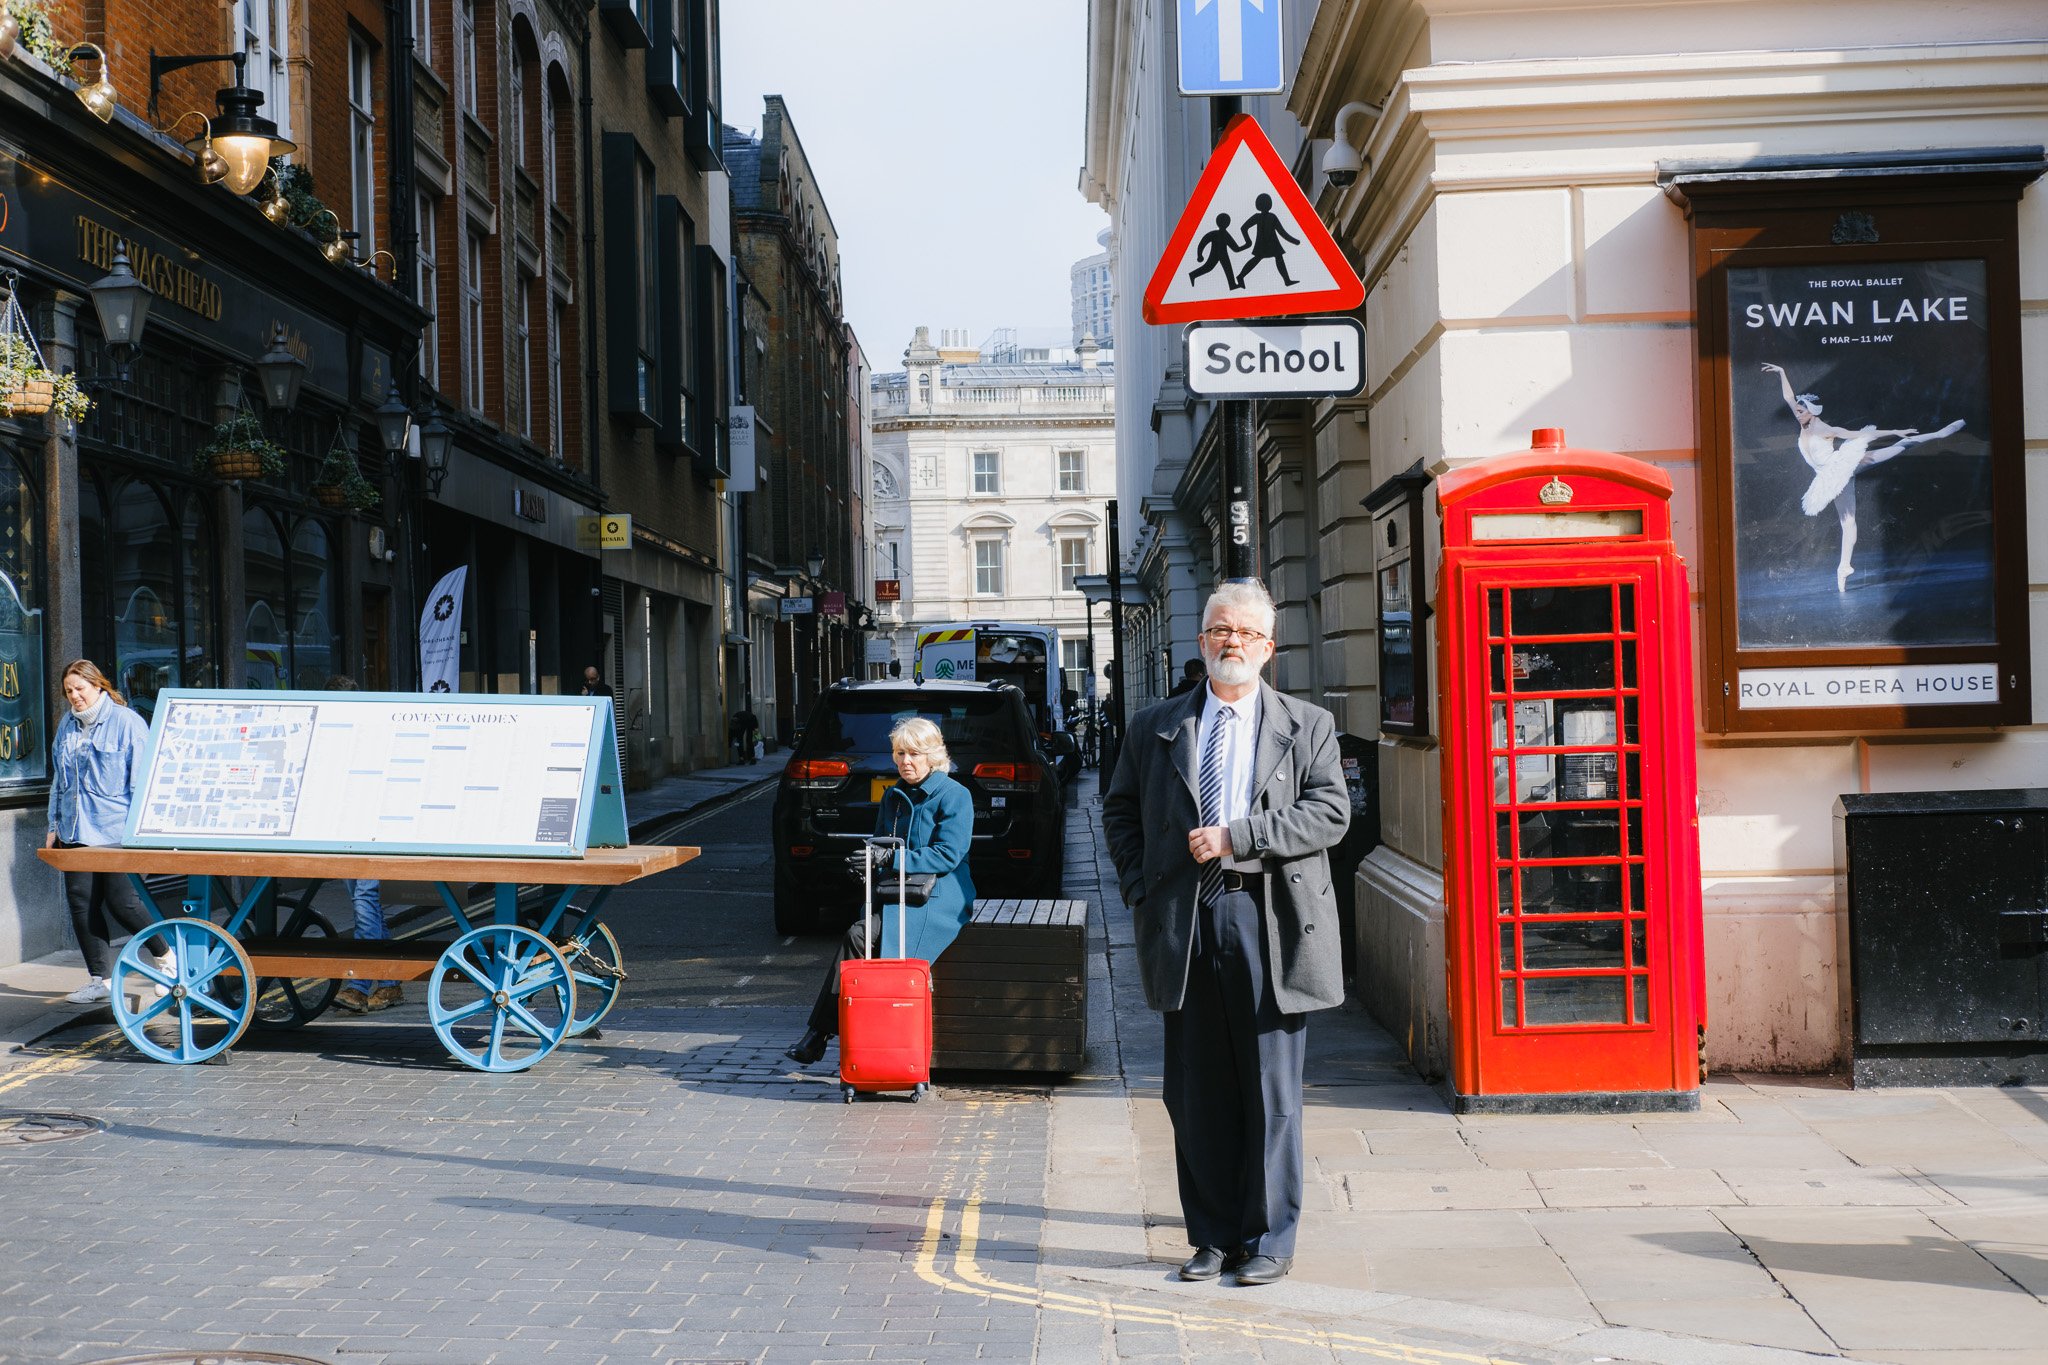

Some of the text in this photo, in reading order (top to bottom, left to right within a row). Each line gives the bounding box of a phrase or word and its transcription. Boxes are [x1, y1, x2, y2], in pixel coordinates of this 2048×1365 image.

[78, 215, 223, 322] THE NAGS HEAD
[1808, 277, 1903, 288] THE ROYAL BALLET
[1745, 296, 1969, 328] SWAN LAKE
[1821, 336, 1827, 344] 6
[1873, 334, 1894, 343] MAY
[1204, 341, 1345, 375] School
[957, 659, 974, 670] ME
[1741, 675, 1994, 697] ROYAL OPERA HOUSE
[391, 712, 518, 724] COVENT GARDEN
